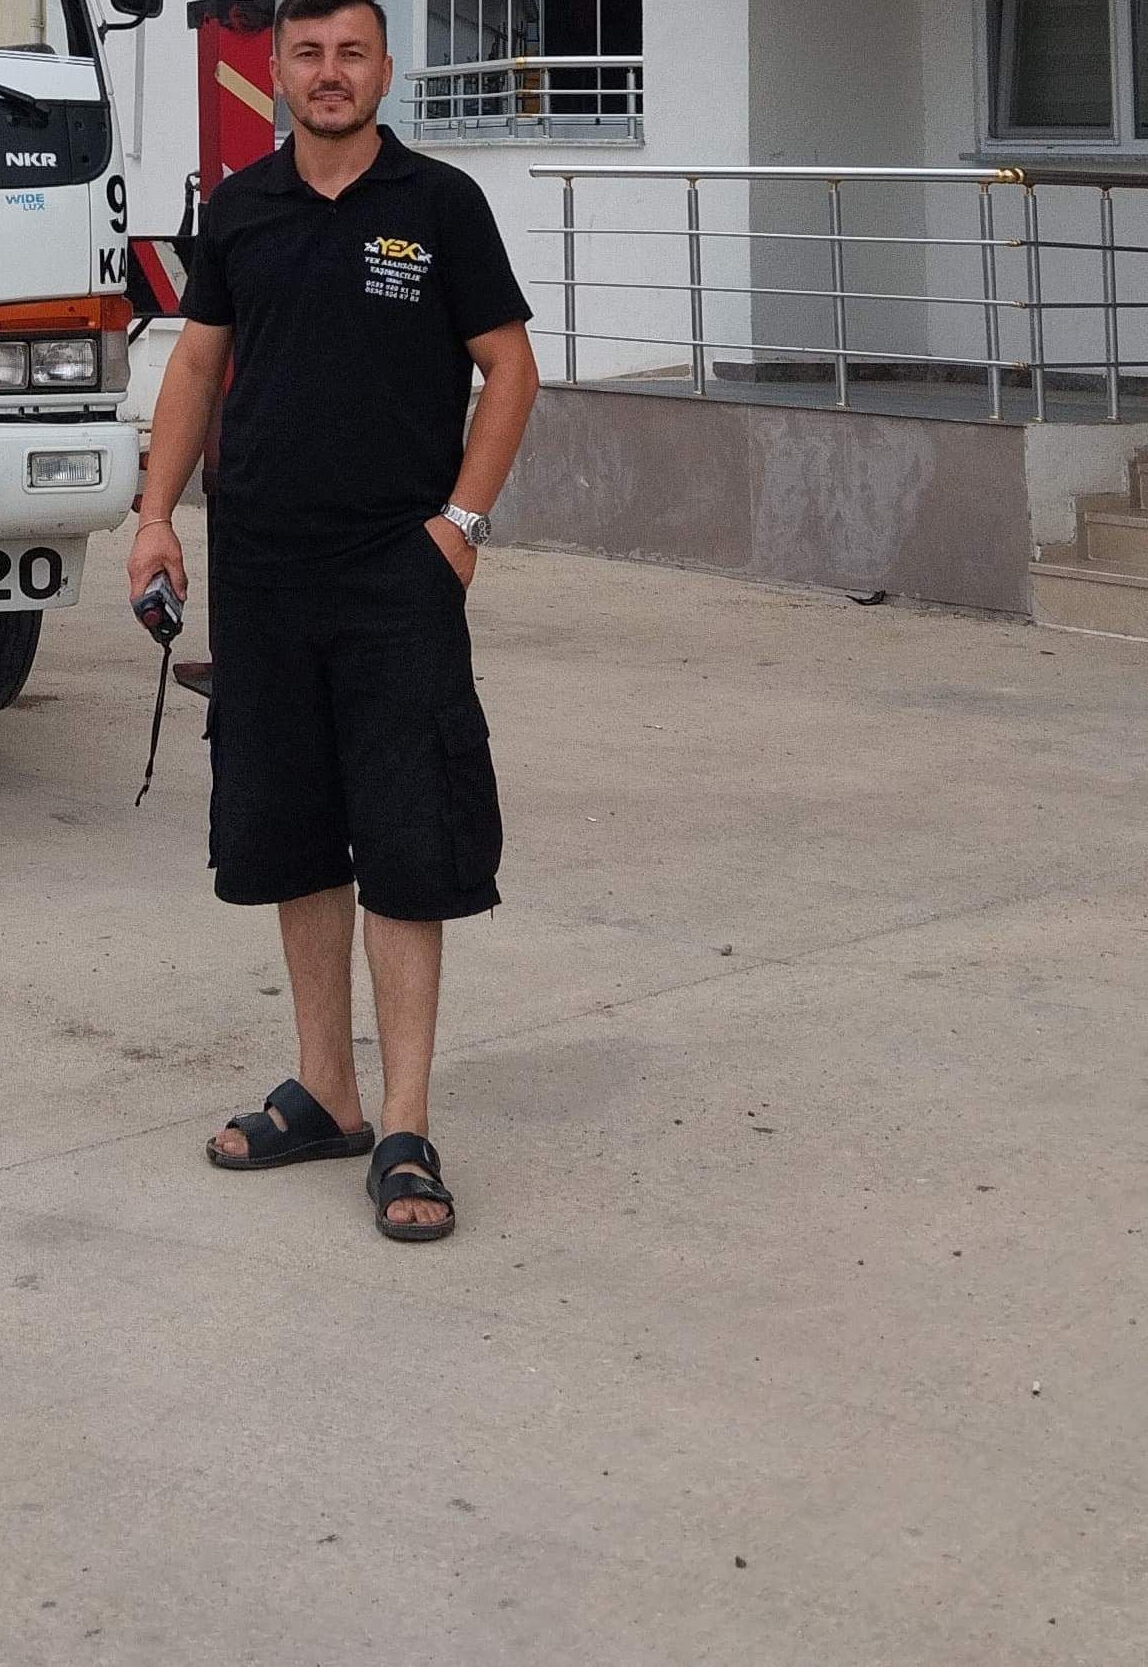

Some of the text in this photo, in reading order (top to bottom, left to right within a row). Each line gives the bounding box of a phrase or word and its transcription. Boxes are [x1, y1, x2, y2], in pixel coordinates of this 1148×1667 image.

[5, 152, 59, 168] NKR
[5, 193, 46, 205] WIDE
[106, 174, 128, 234] 9
[22, 203, 46, 212] LUX
[99, 247, 127, 285] KA
